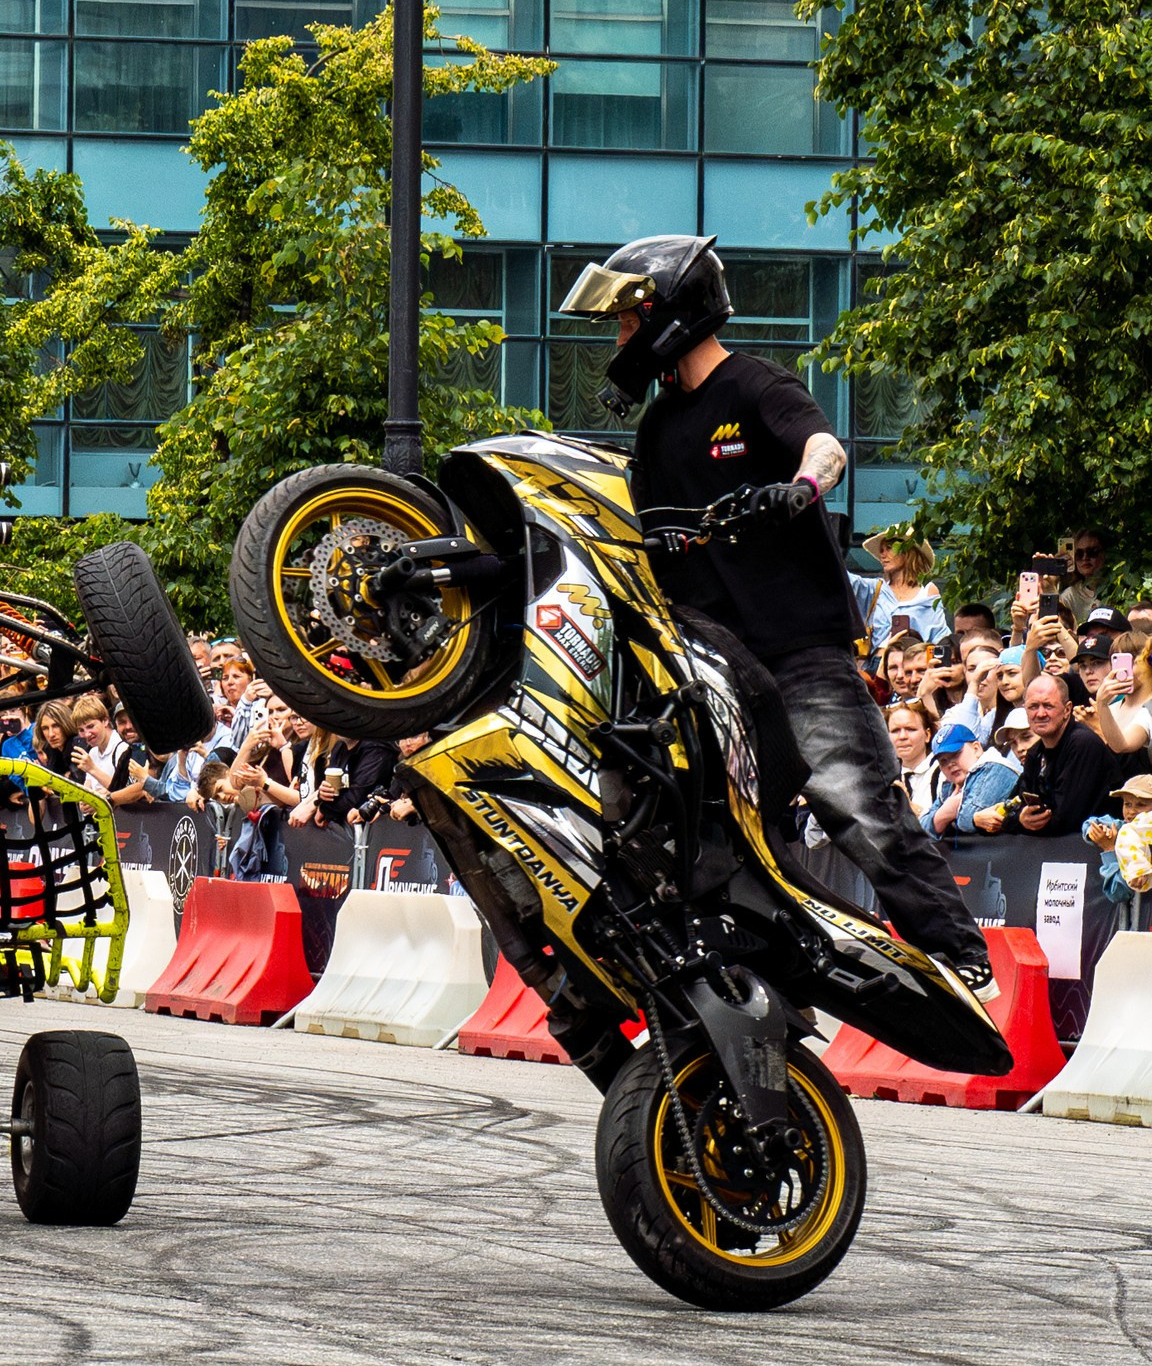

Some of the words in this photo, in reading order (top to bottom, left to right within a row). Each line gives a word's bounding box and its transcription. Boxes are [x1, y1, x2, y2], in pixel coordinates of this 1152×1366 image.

[554, 632, 571, 648] MAX
[569, 647, 593, 674] ENERGY
[560, 622, 602, 671] TORNADO
[804, 899, 836, 919] NO
[843, 921, 907, 959] LIMIT
